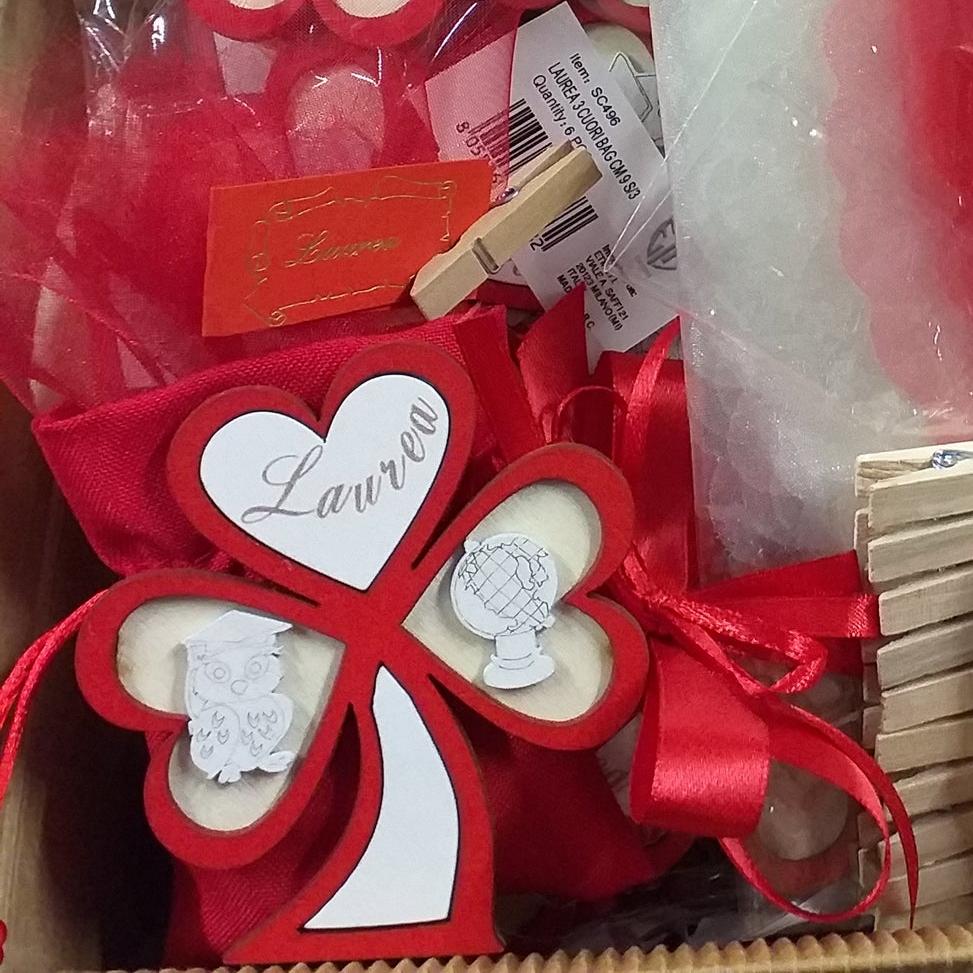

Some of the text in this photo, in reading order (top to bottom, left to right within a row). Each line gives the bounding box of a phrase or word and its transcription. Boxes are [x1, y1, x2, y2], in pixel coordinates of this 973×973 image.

[548, 61, 581, 104] LAUREA
[577, 107, 606, 141] CUORI
[595, 136, 618, 162] BAG
[623, 181, 641, 200] S/3
[569, 52, 621, 126] Item: SC496
[556, 274, 573, 295] MAD
[241, 397, 439, 524] Laurea
